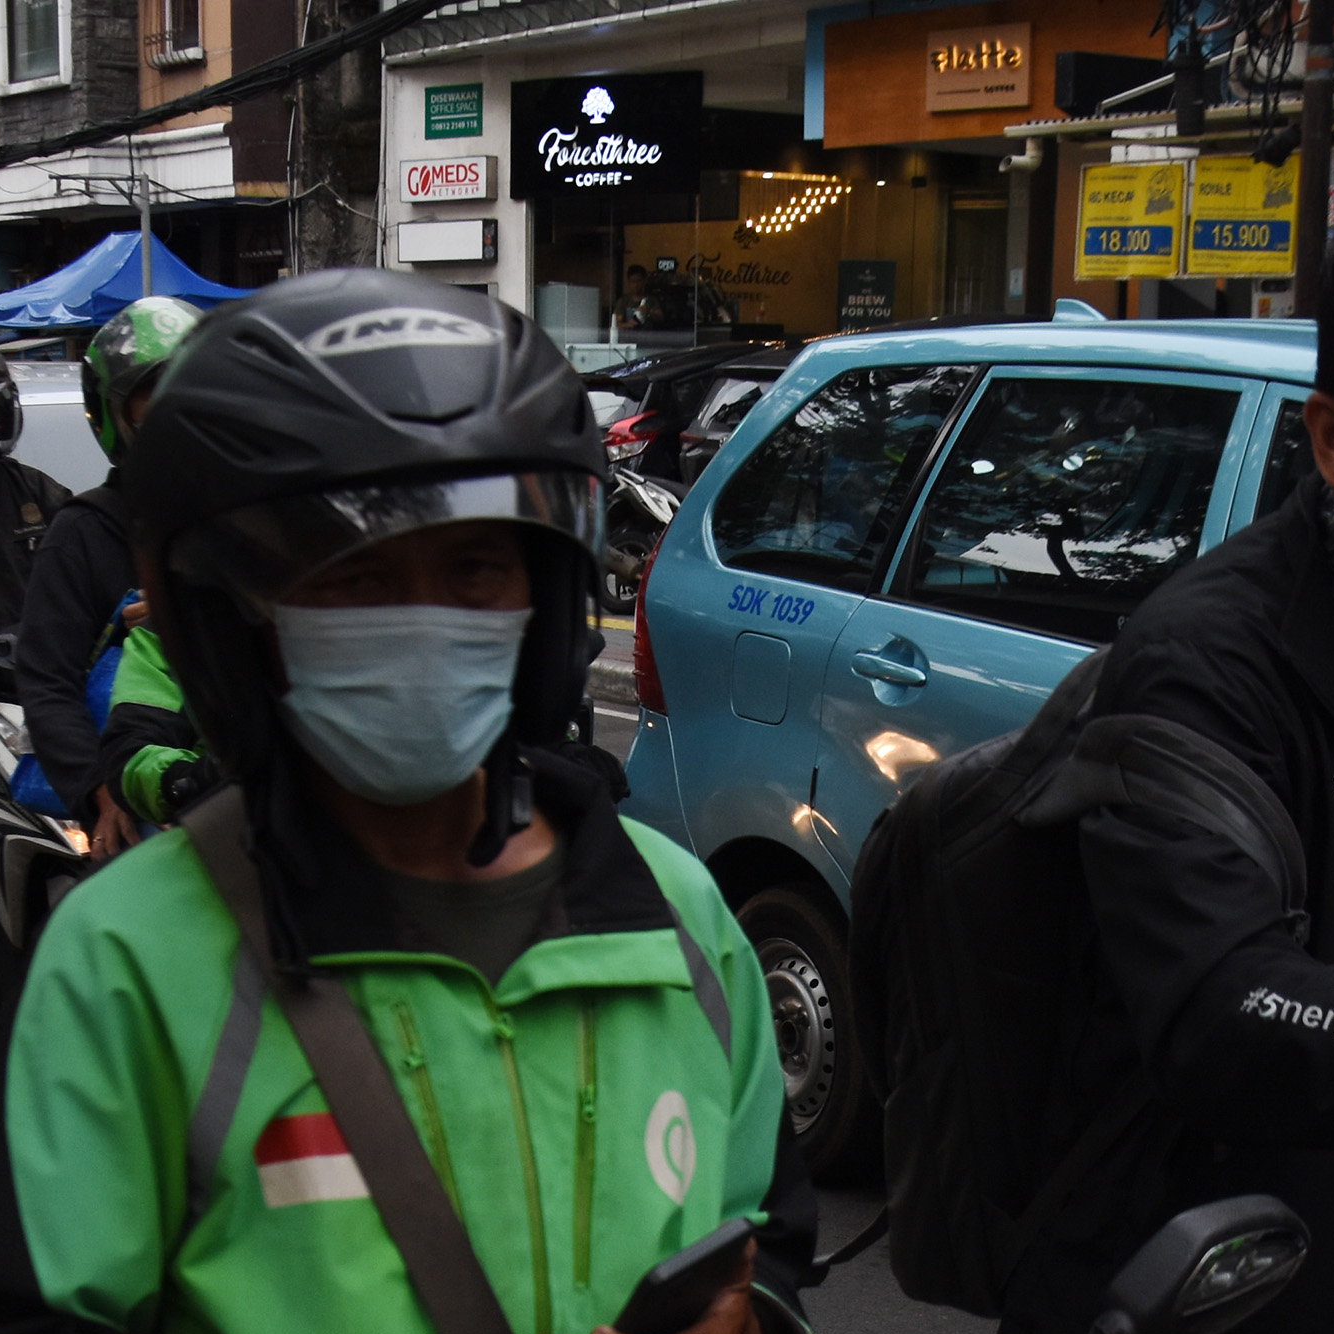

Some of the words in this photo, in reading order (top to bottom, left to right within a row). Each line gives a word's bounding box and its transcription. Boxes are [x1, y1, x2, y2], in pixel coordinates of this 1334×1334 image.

[430, 91, 478, 104] DISEWAKAN
[430, 103, 455, 114] OFFICE
[455, 101, 477, 113] SPACE
[538, 125, 663, 172] Foresthree
[1211, 224, 1271, 249] 15.900
[847, 295, 886, 307] BREW
[841, 307, 864, 318] FOR
[867, 306, 892, 318] YOU
[325, 318, 469, 348] INK
[727, 585, 770, 616] SDK
[770, 593, 816, 626] 1039
